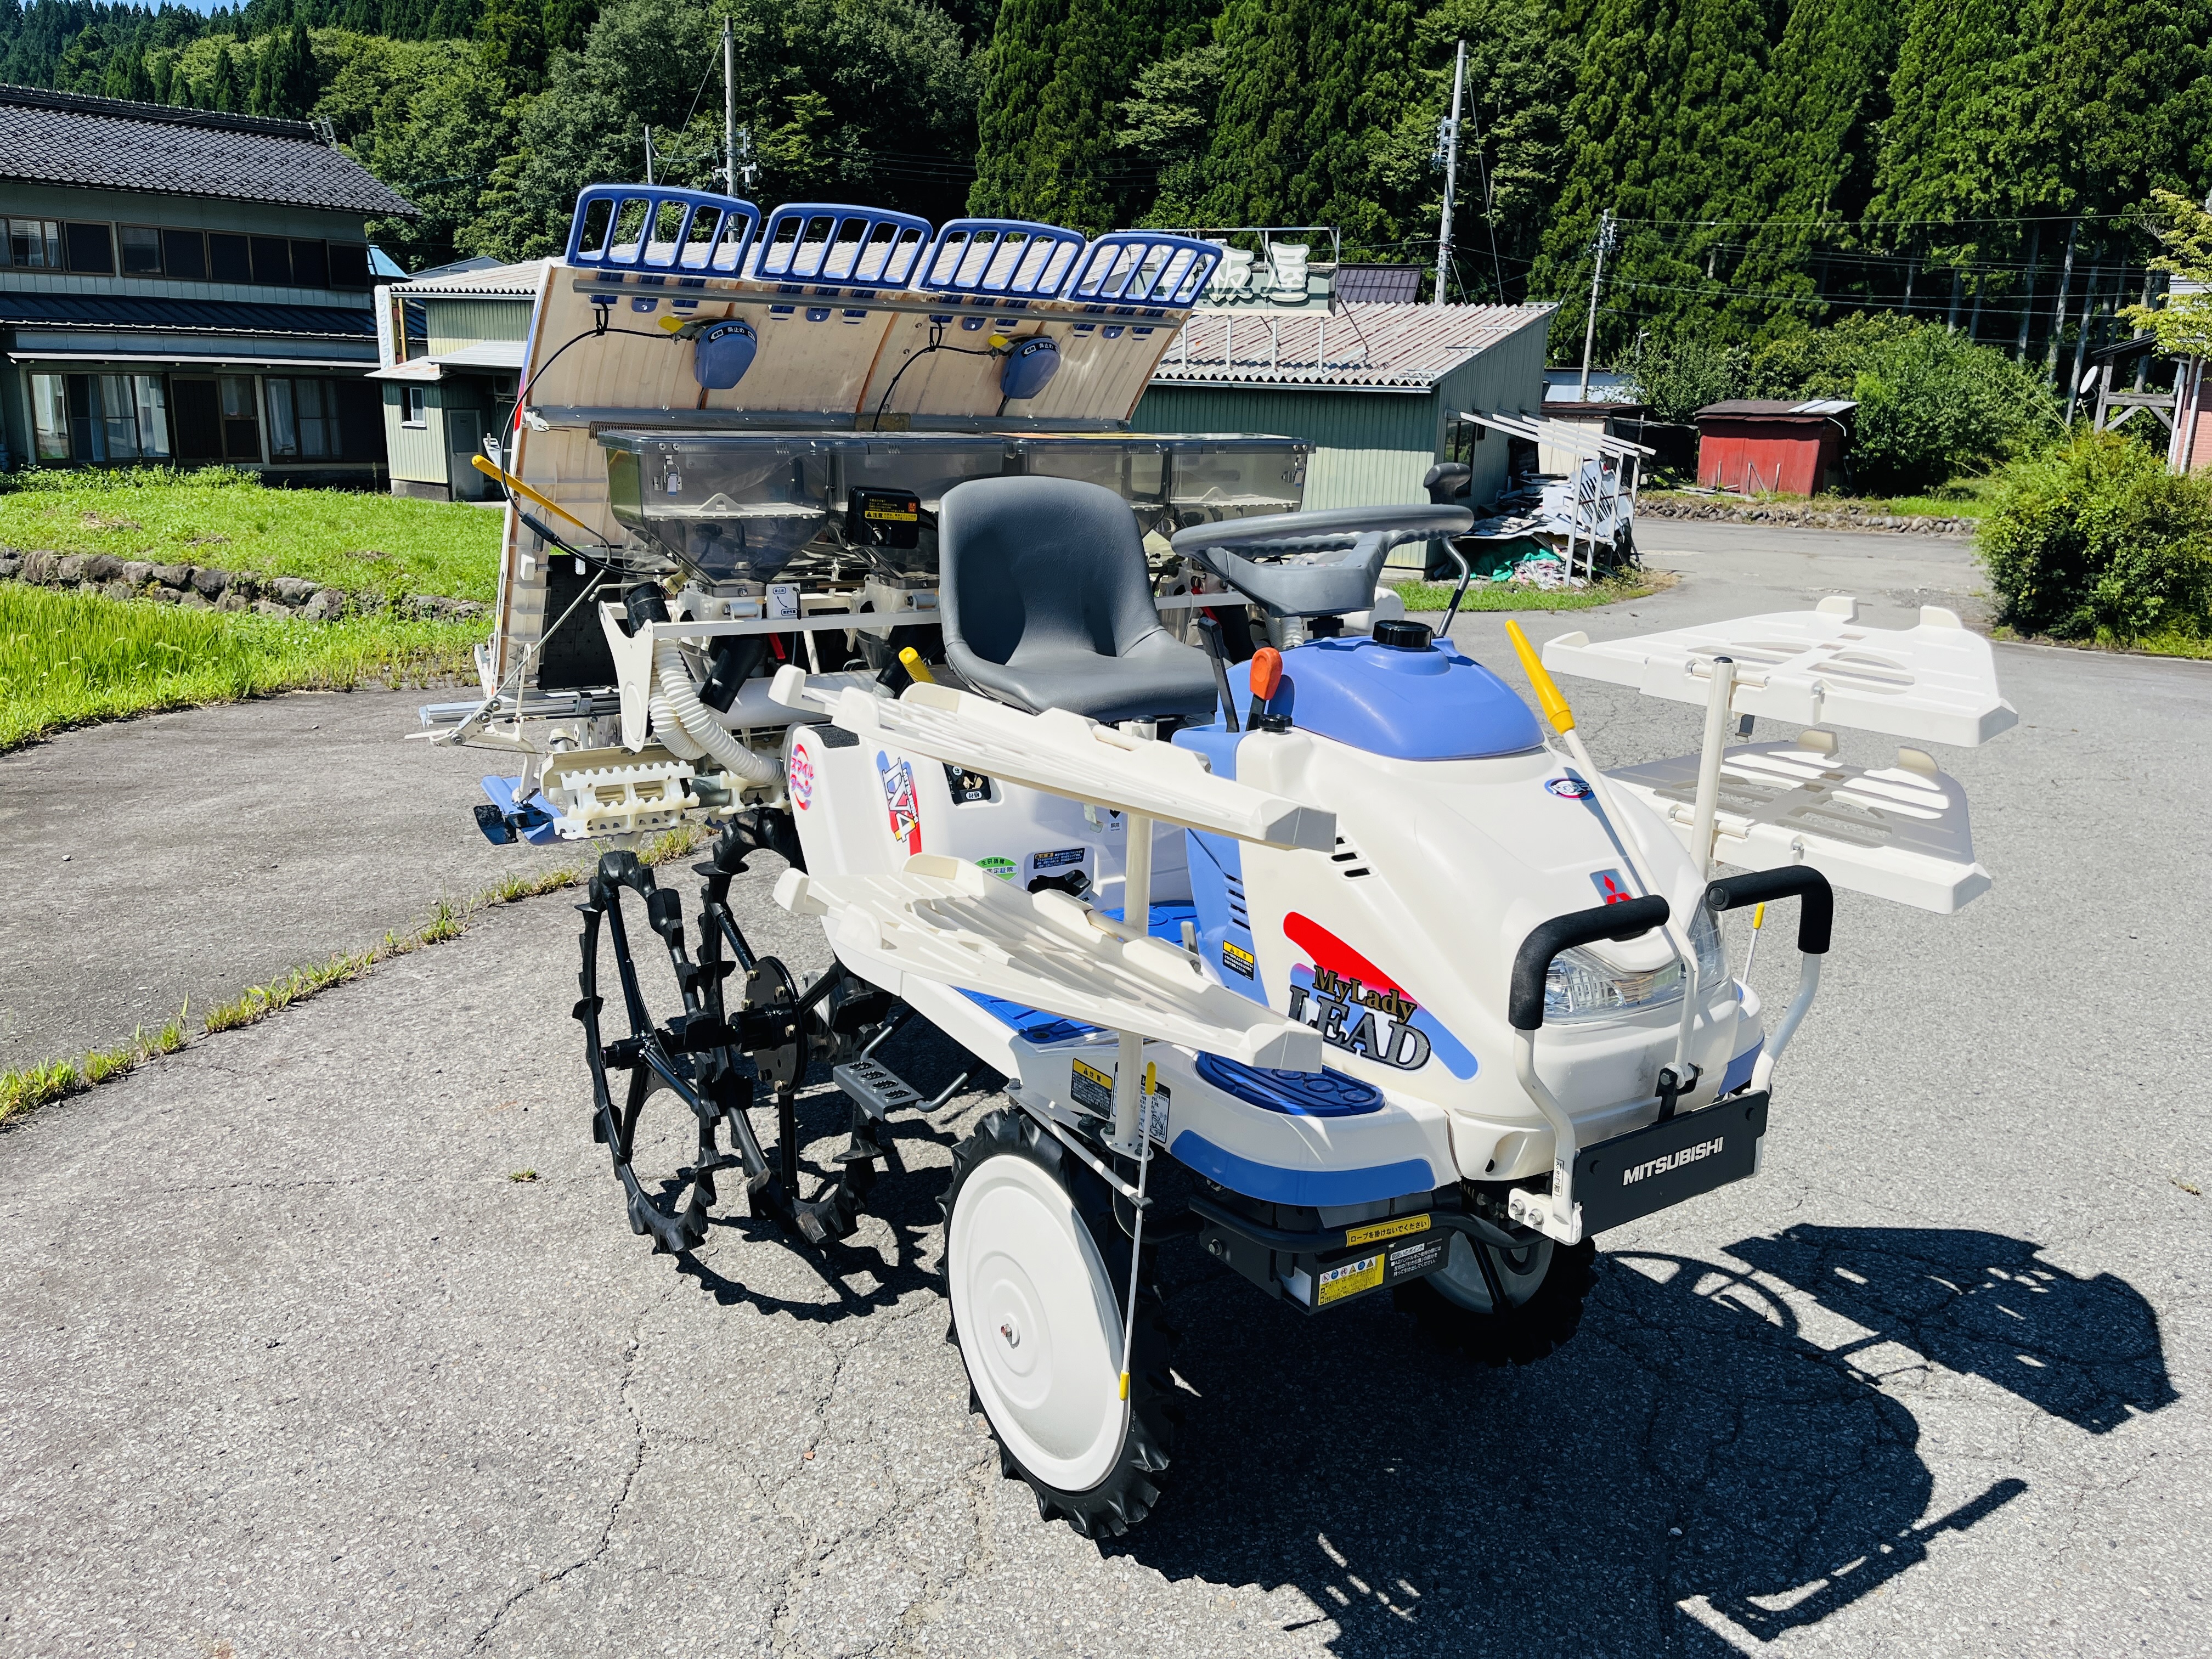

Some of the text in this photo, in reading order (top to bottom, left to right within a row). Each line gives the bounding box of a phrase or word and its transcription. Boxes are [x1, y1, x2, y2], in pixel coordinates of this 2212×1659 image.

[791, 757, 814, 780] スマイル
[902, 768, 919, 824] MITSUBISHI
[1312, 964, 1417, 1024] MyLady
[1288, 985, 1431, 1070] LEAD
[1623, 1136, 1724, 1186] MITSUBISHI
[1351, 1221, 1427, 1243] ロープを掛けないでください
